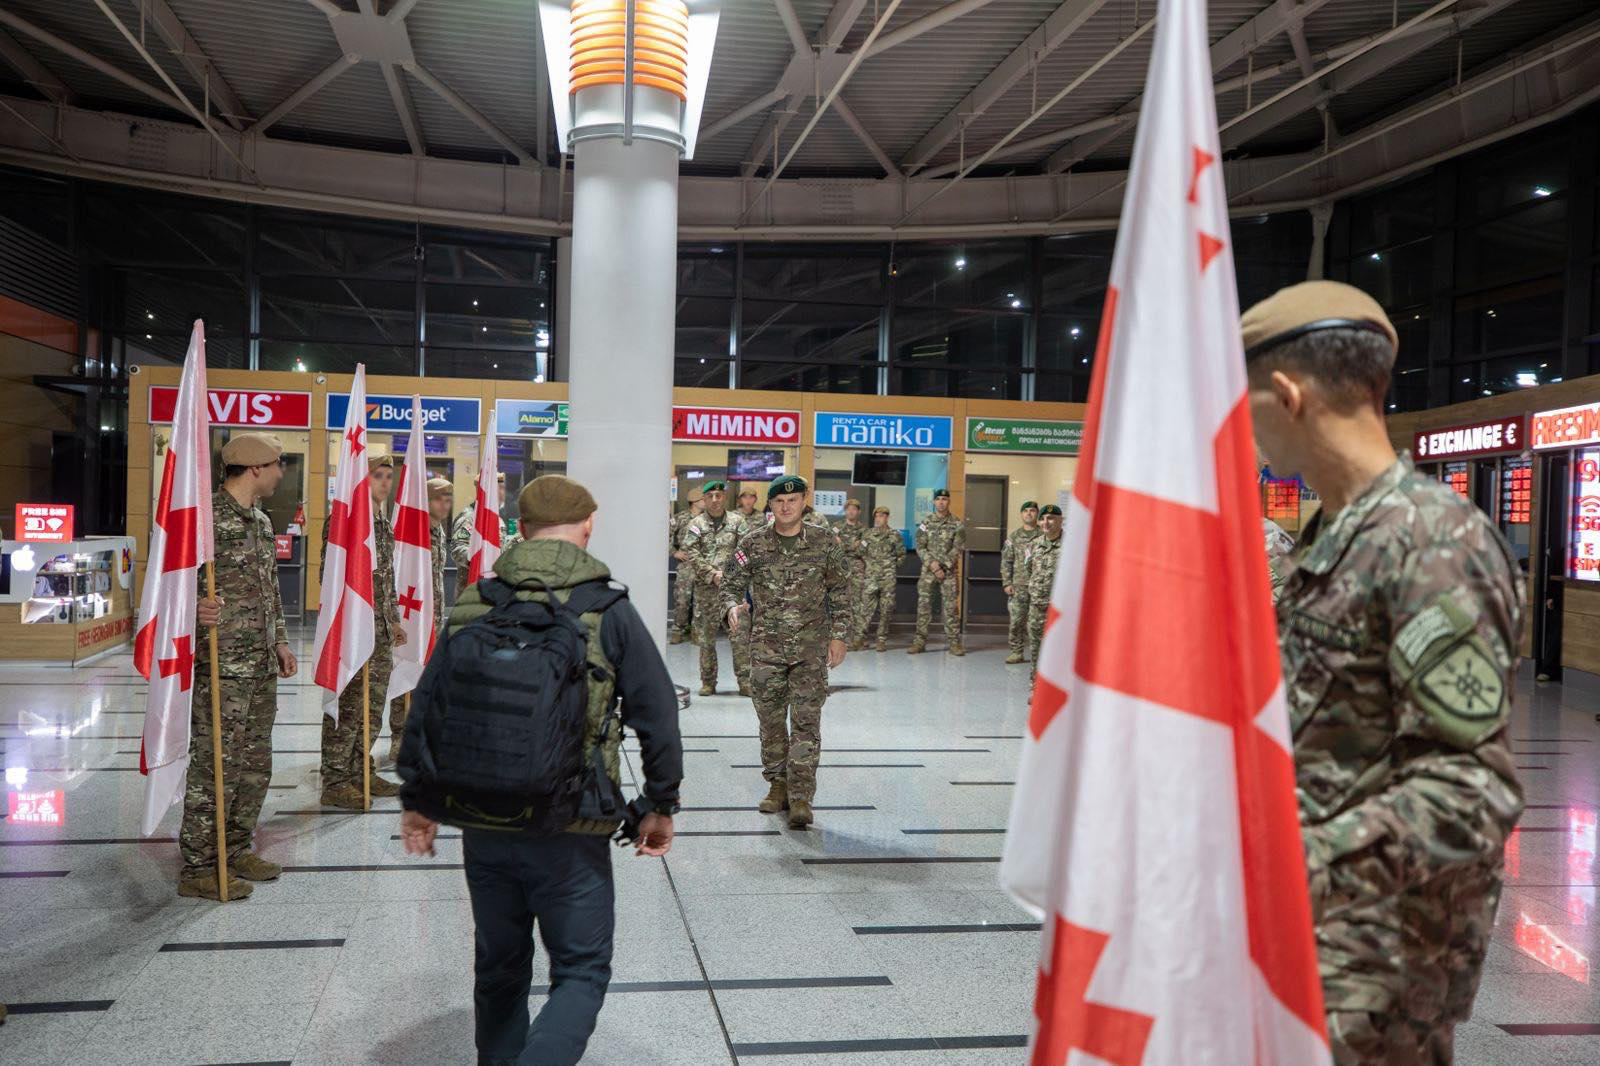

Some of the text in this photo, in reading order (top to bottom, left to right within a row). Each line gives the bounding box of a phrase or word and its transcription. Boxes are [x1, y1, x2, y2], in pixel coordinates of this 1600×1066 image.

[207, 393, 273, 425] VIS
[520, 413, 553, 424] Alamo
[832, 417, 857, 425] RENT
[867, 418, 887, 426] CAR
[686, 413, 796, 438] MiMiNO
[832, 419, 933, 446] naniko
[1429, 424, 1502, 455] EXCHANGE
